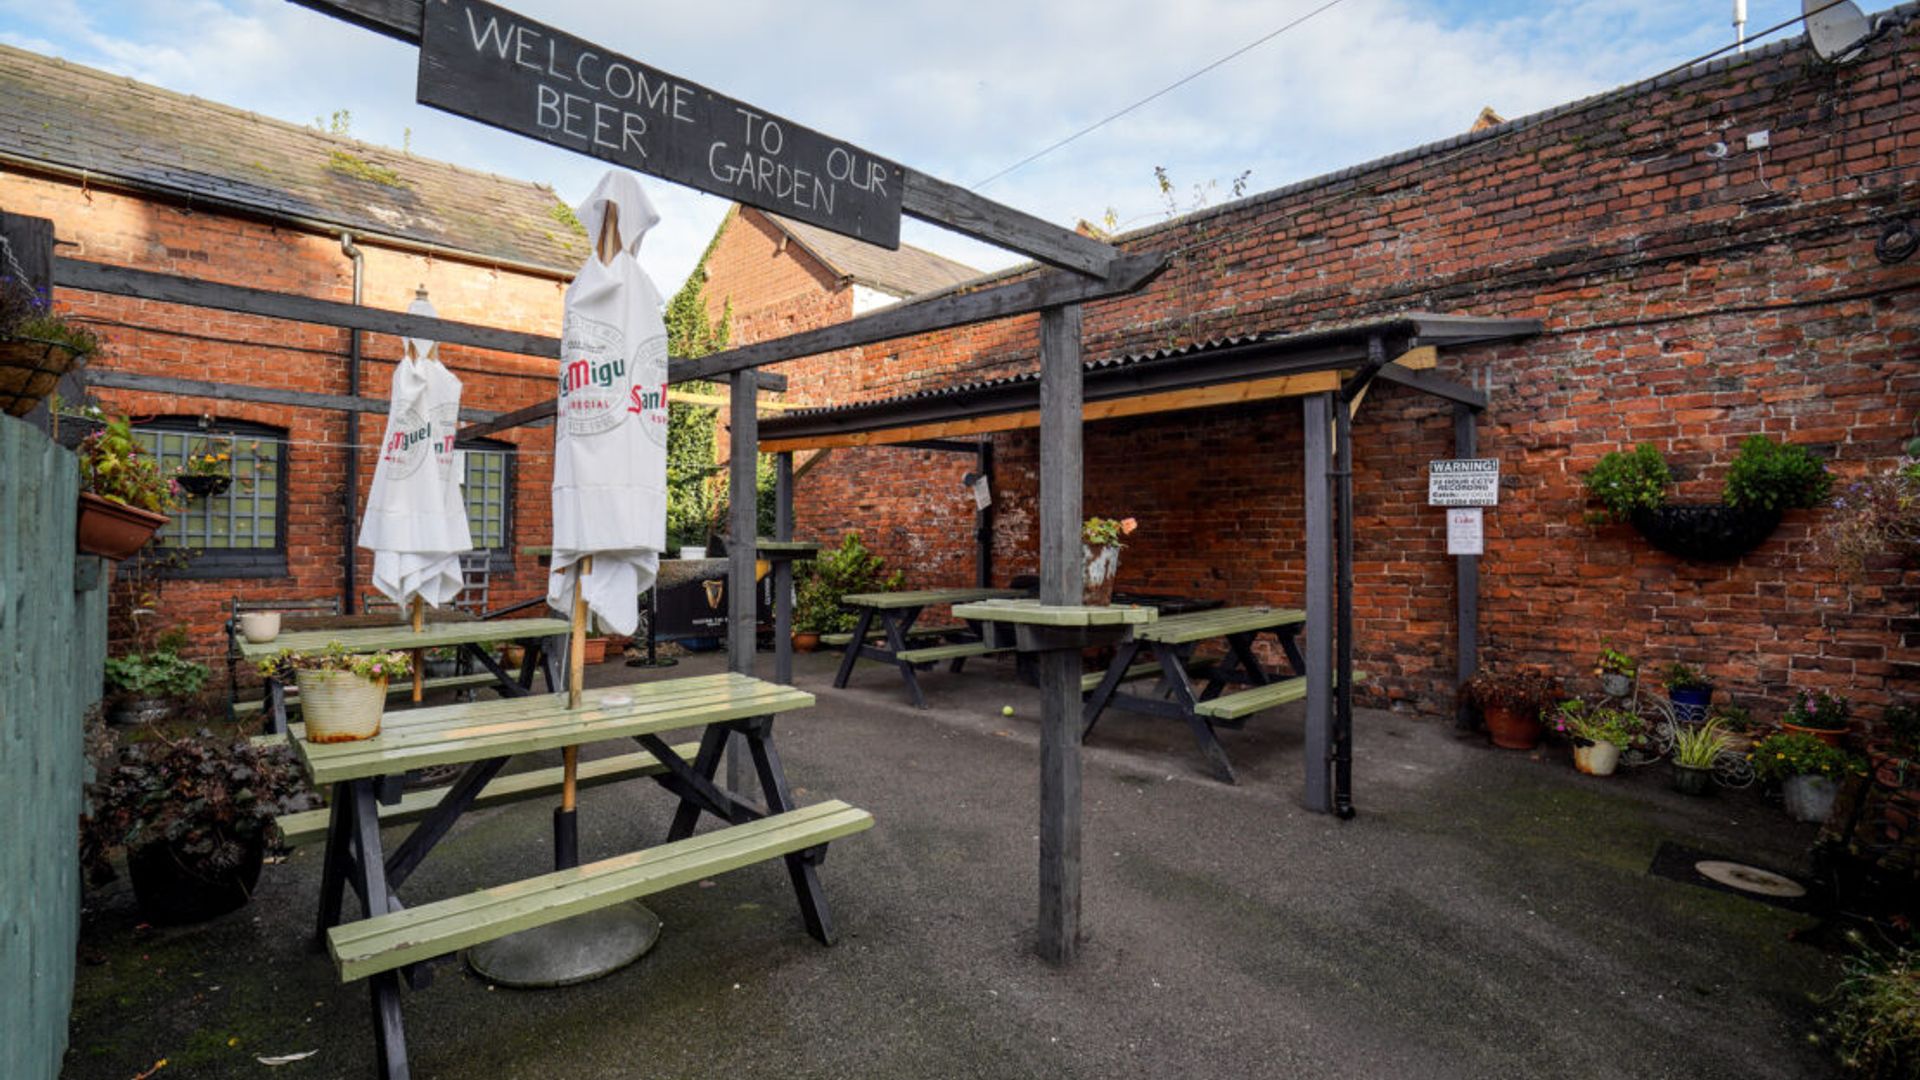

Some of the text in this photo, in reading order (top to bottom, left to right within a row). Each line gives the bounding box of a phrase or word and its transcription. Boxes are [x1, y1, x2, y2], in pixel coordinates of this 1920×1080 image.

[465, 7, 888, 198] WELCOME TO OUR
[536, 83, 835, 215] BEER GARDEN
[1432, 461, 1497, 473] WARNING!
[1437, 484, 1490, 492] RECORDING
